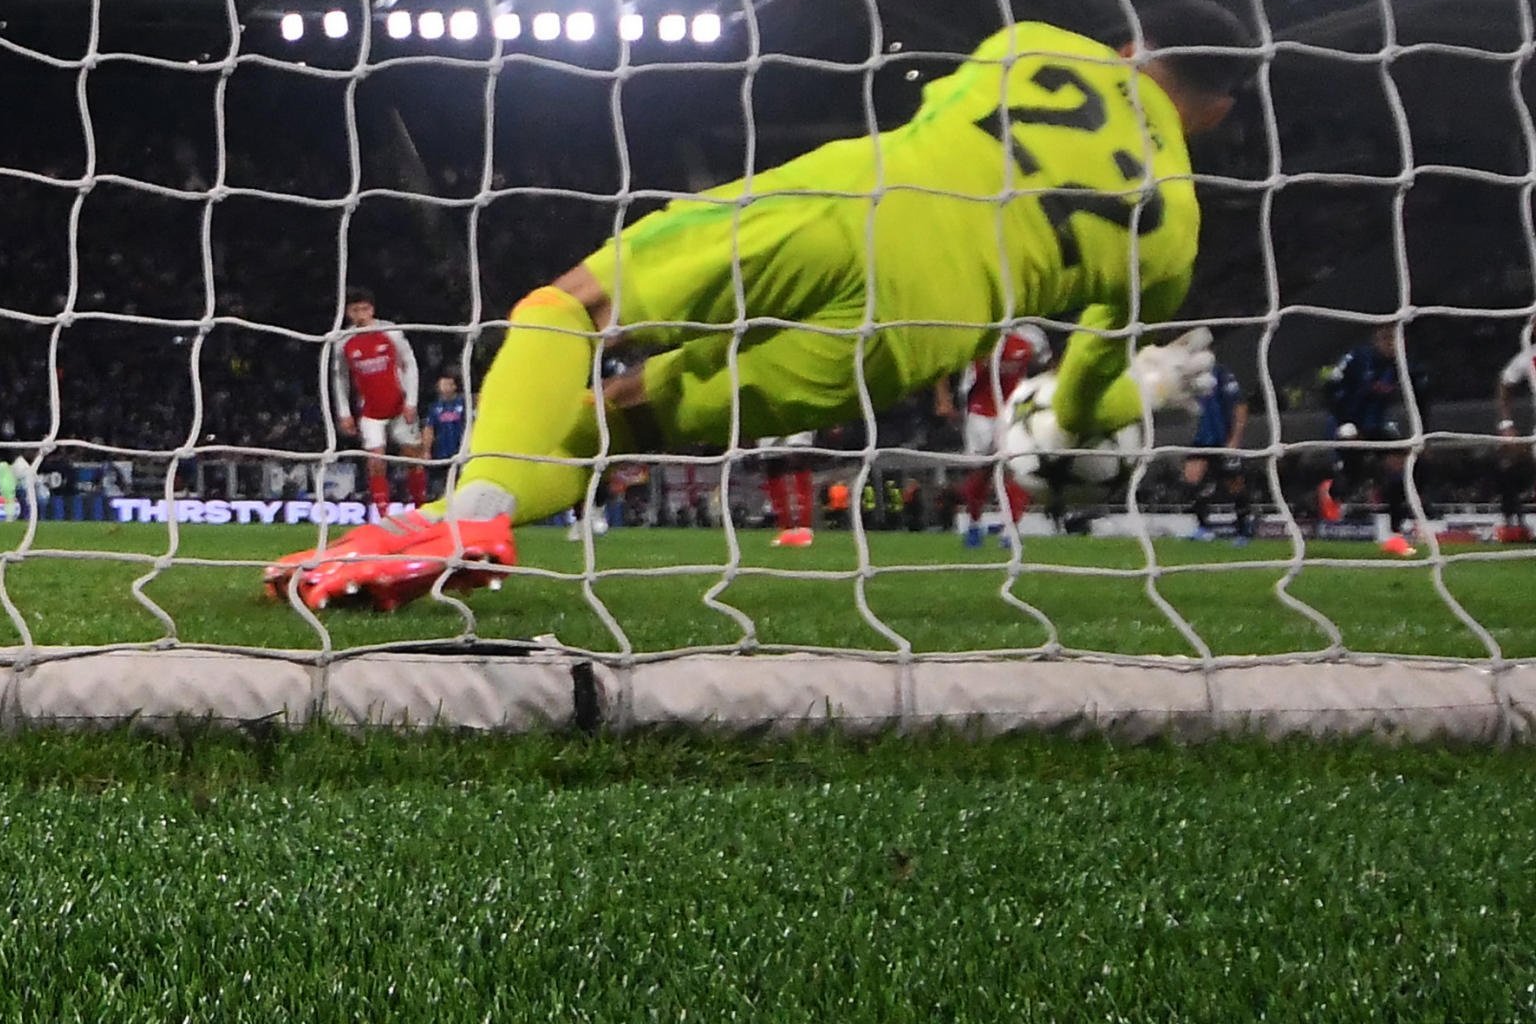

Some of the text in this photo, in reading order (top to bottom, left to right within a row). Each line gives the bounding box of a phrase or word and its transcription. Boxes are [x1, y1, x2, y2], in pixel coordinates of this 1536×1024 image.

[972, 64, 1164, 269] 22
[110, 498, 284, 524] THRSTY
[285, 500, 366, 524] FOR
